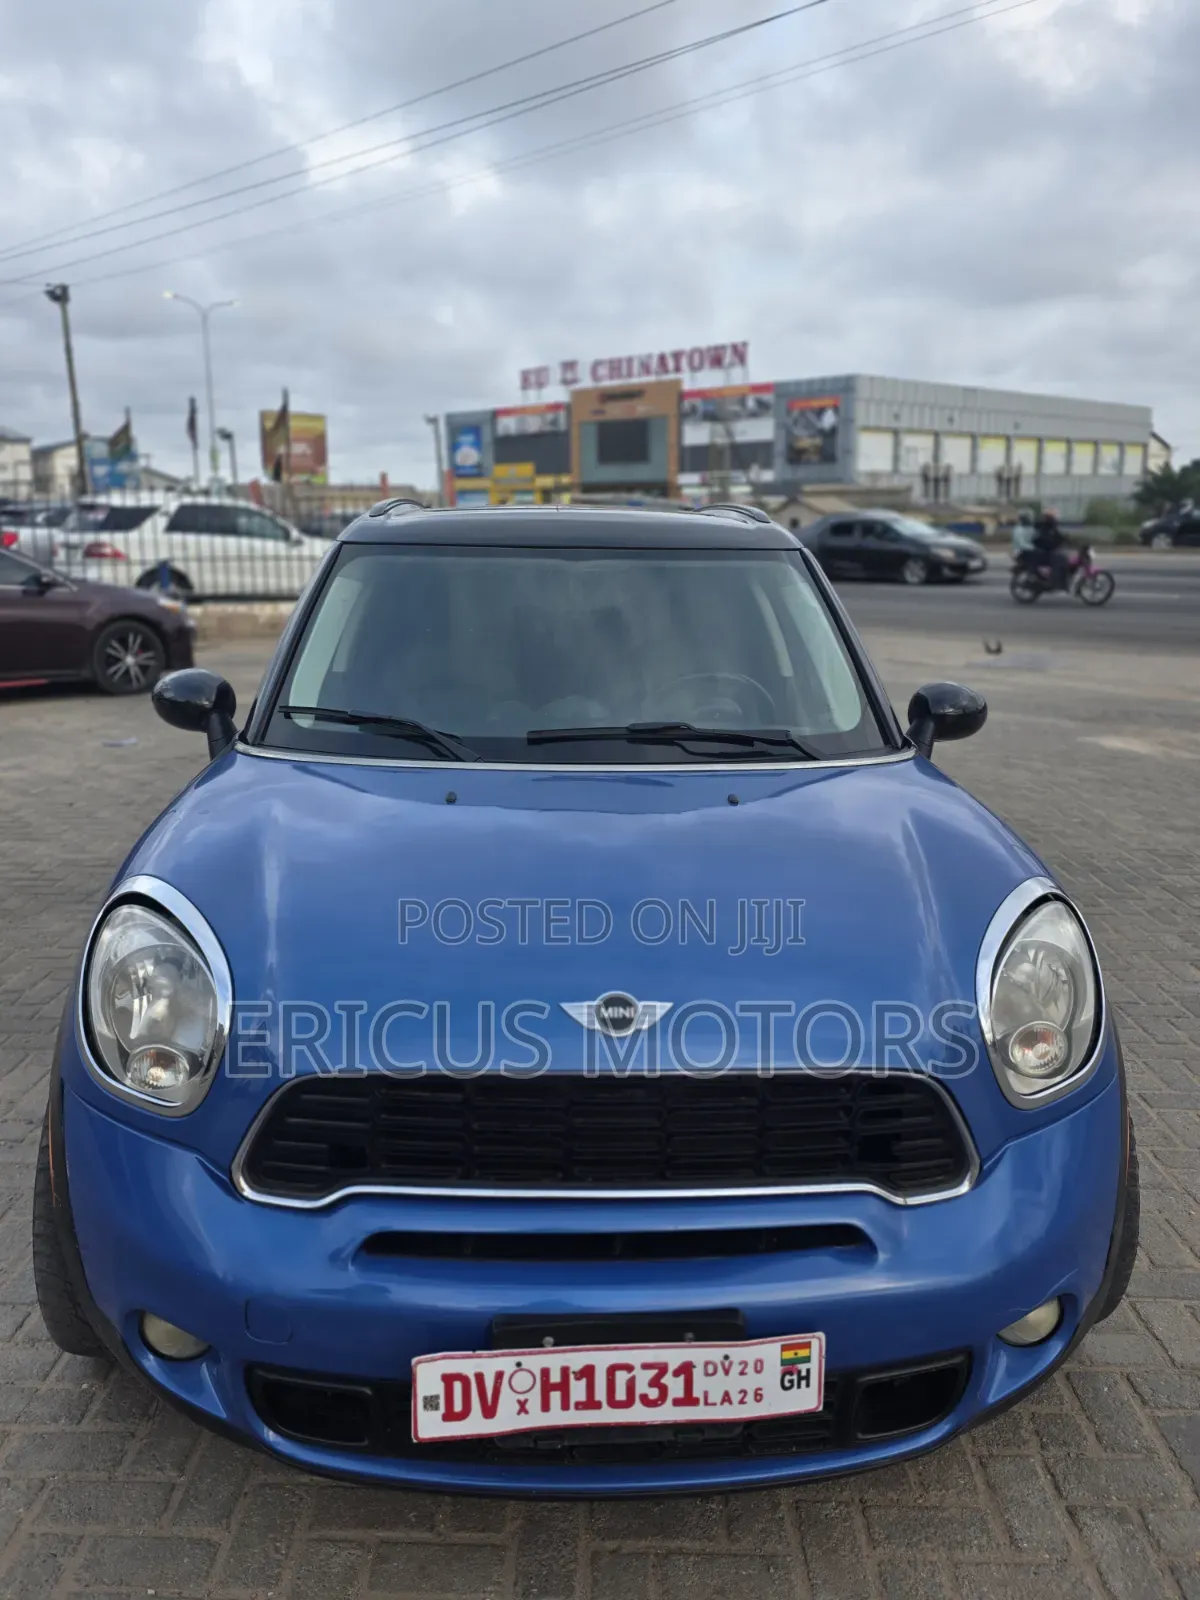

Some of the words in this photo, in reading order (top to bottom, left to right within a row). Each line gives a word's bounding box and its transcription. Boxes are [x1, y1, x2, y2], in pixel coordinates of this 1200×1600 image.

[591, 341, 748, 382] CHINATOWN
[600, 1006, 635, 1019] MINI
[780, 1367, 811, 1391] GH
[703, 1387, 763, 1406] LA26
